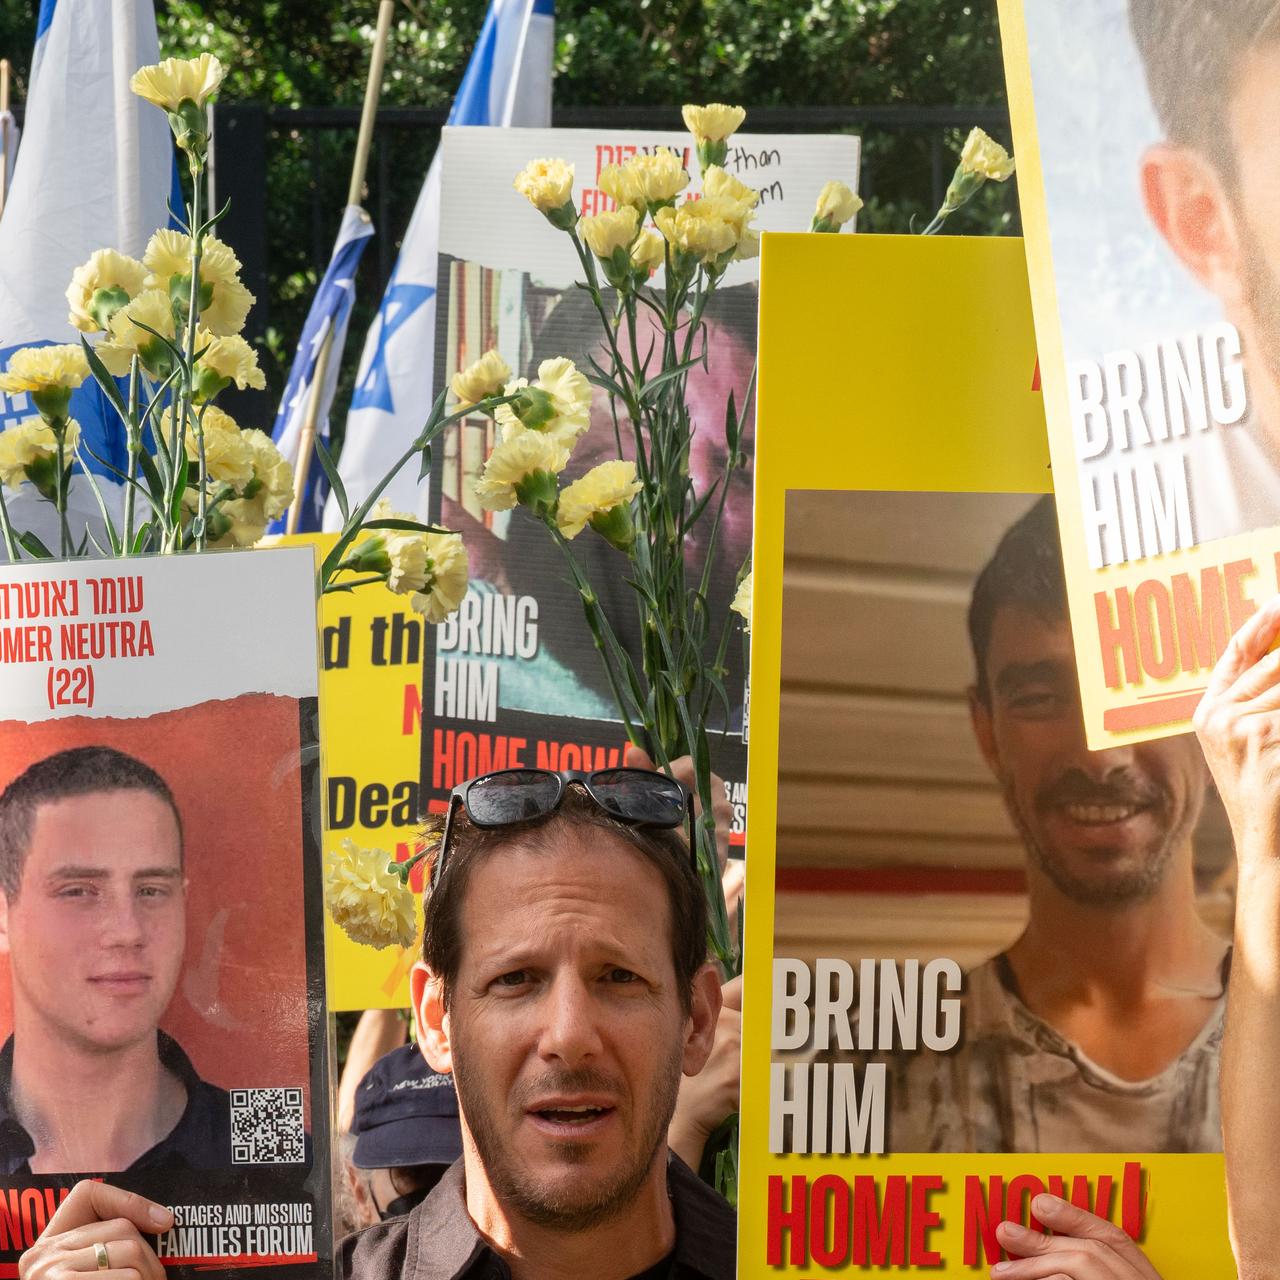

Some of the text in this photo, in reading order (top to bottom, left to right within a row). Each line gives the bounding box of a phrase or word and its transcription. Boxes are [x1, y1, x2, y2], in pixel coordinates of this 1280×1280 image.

[1068, 320, 1247, 463] BRING
[1078, 450, 1197, 570] HIM
[85, 575, 145, 616] עומר
[436, 591, 539, 660] BRING
[1094, 556, 1264, 690] HOME
[60, 619, 155, 661] NEUTRA
[46, 664, 96, 711] (22)
[434, 656, 499, 723] HIM
[771, 957, 963, 1053] BRING
[768, 1062, 888, 1156] HIM
[157, 1225, 313, 1258] FAMILIES FORUM
[166, 1203, 313, 1227] STAGES AND MISSING
[767, 1173, 944, 1268] HOME
